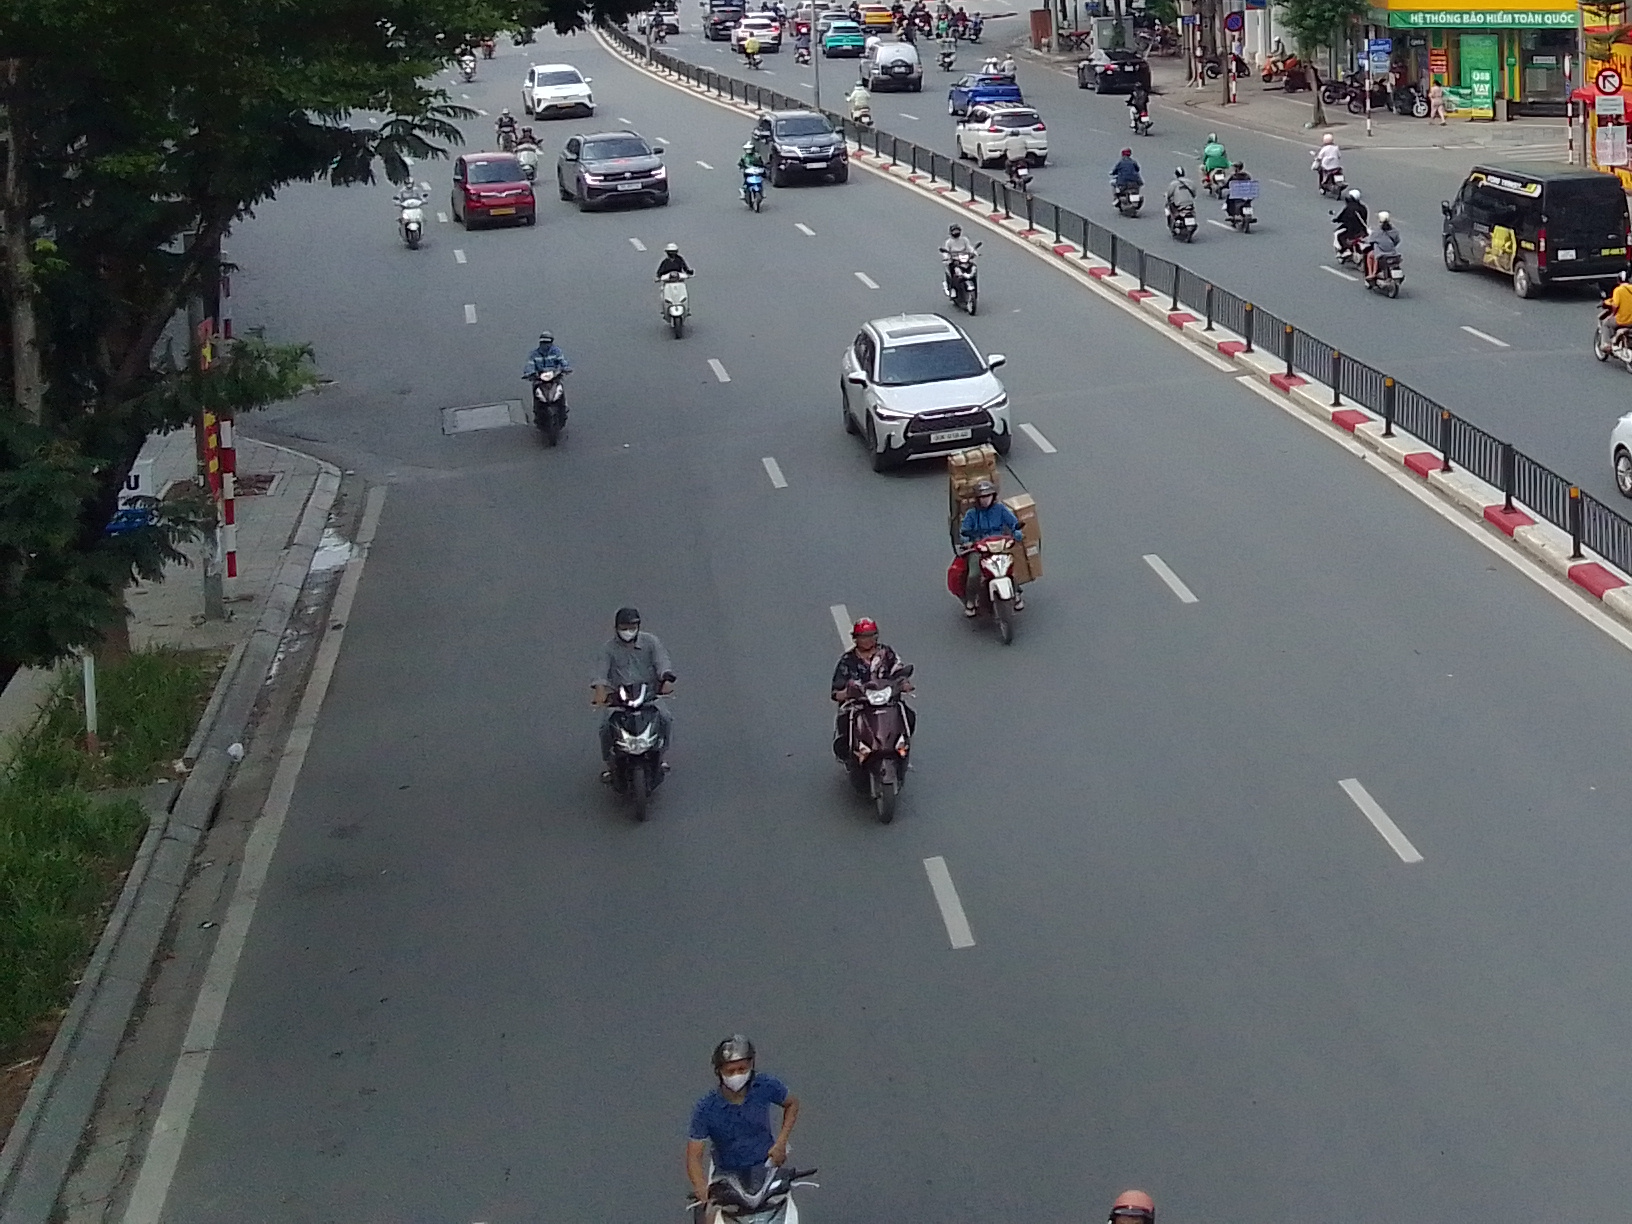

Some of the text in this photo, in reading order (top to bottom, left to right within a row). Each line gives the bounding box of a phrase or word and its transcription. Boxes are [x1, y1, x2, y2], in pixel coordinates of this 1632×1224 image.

[1410, 11, 1574, 25] HỆ THỐNG BẢO HIỂM TOÀN QUỐC
